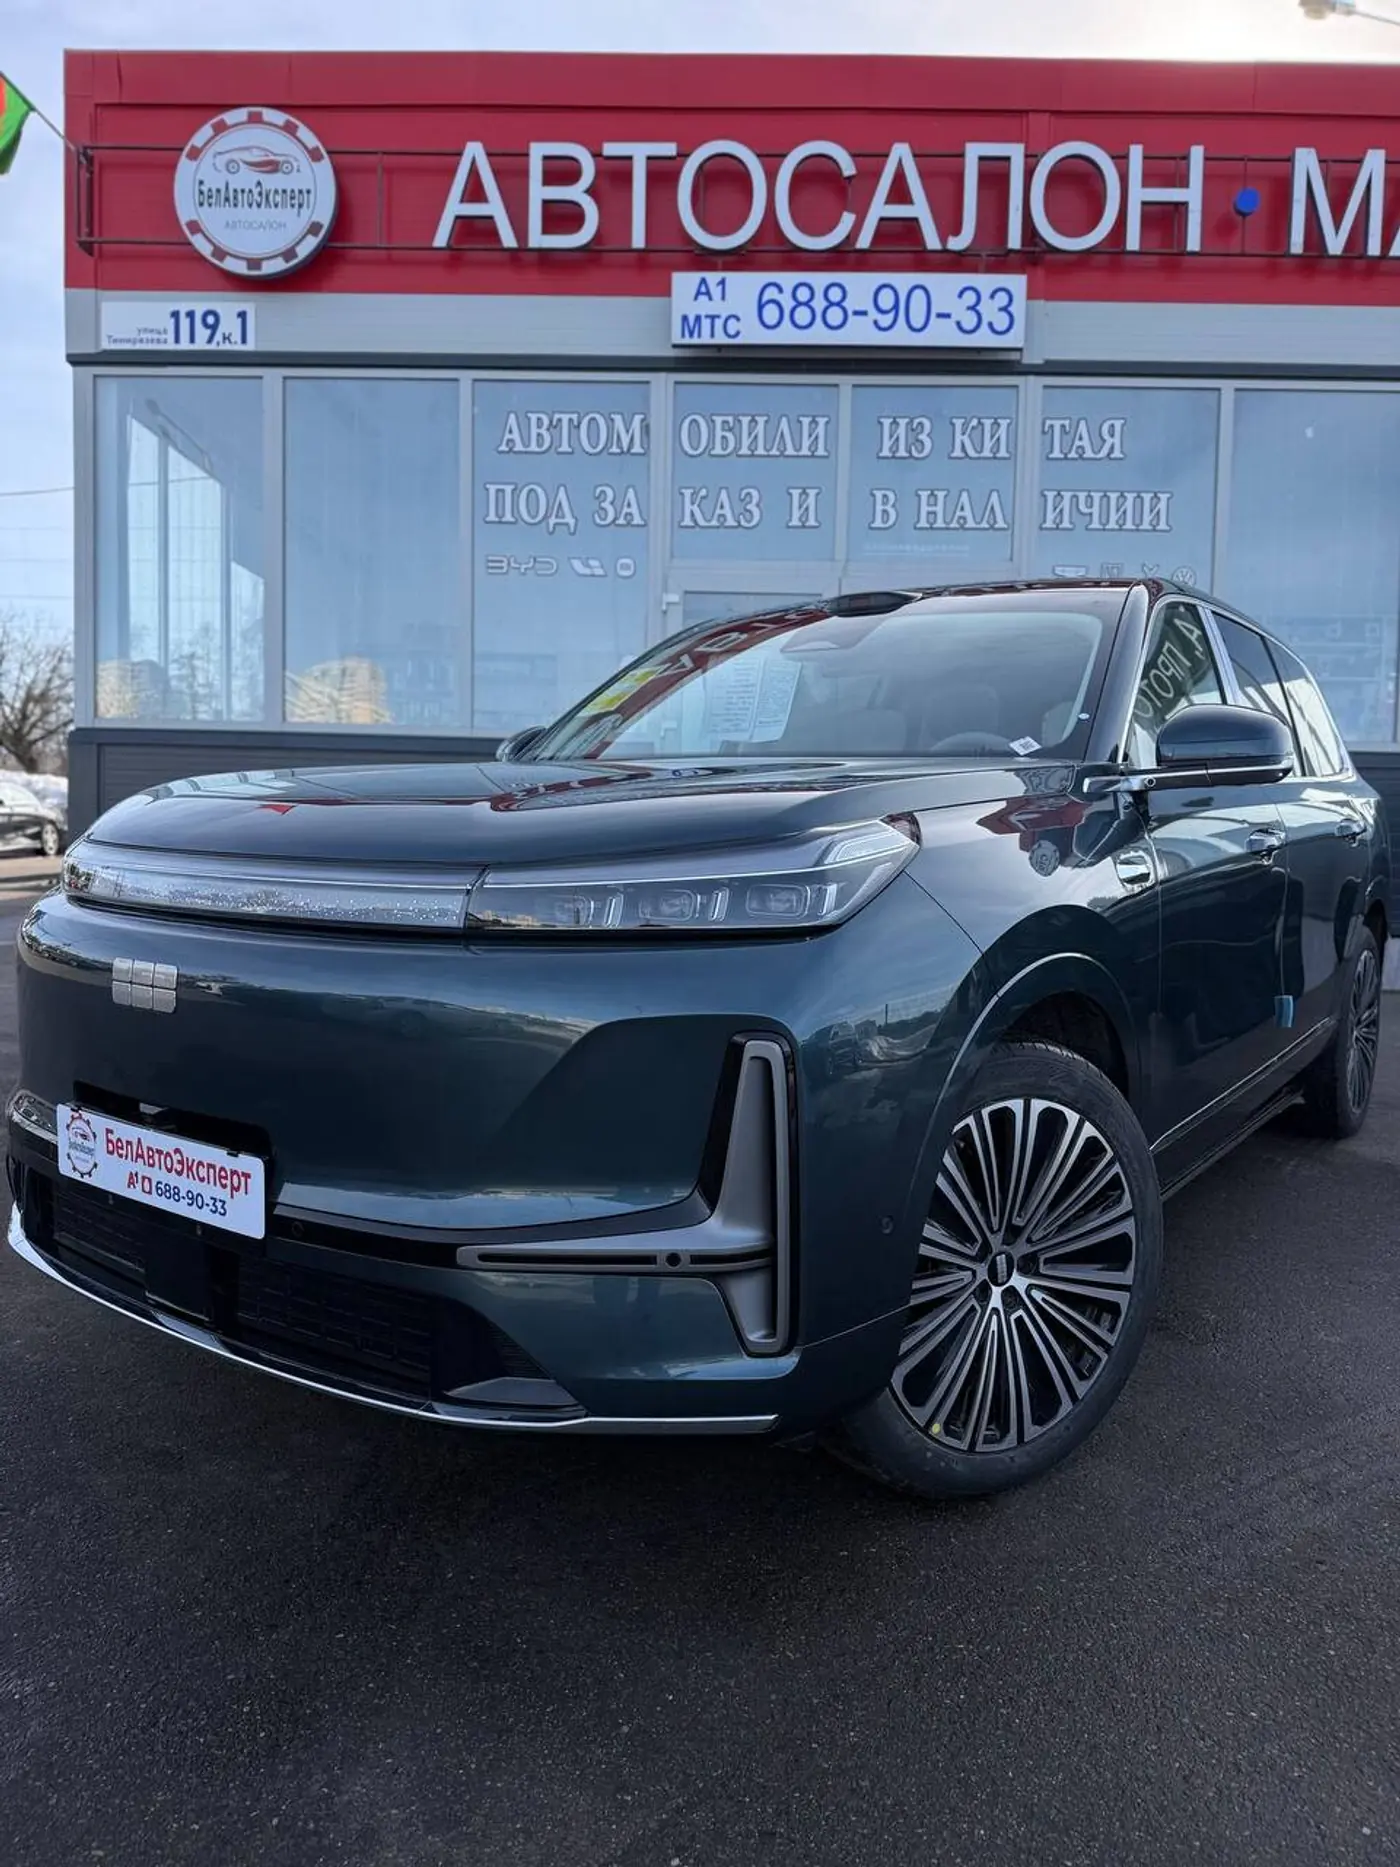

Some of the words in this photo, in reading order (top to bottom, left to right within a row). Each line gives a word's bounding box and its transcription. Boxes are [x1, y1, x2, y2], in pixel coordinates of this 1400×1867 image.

[197, 180, 313, 217] БелАвтоЭксперт
[432, 139, 1205, 252] АВТОСАЛОН
[1289, 146, 1400, 257] М
[224, 220, 287, 232] АВТОСАЛОН
[680, 313, 742, 339] МТС
[756, 281, 1015, 336] 688-90-33
[878, 416, 933, 459] ИЗ
[485, 482, 578, 534] ПОД
[787, 488, 820, 527] И
[870, 489, 898, 529] В
[105, 1127, 252, 1199] БелАвтоЭксперт
[155, 1181, 228, 1217] 688-90-33
